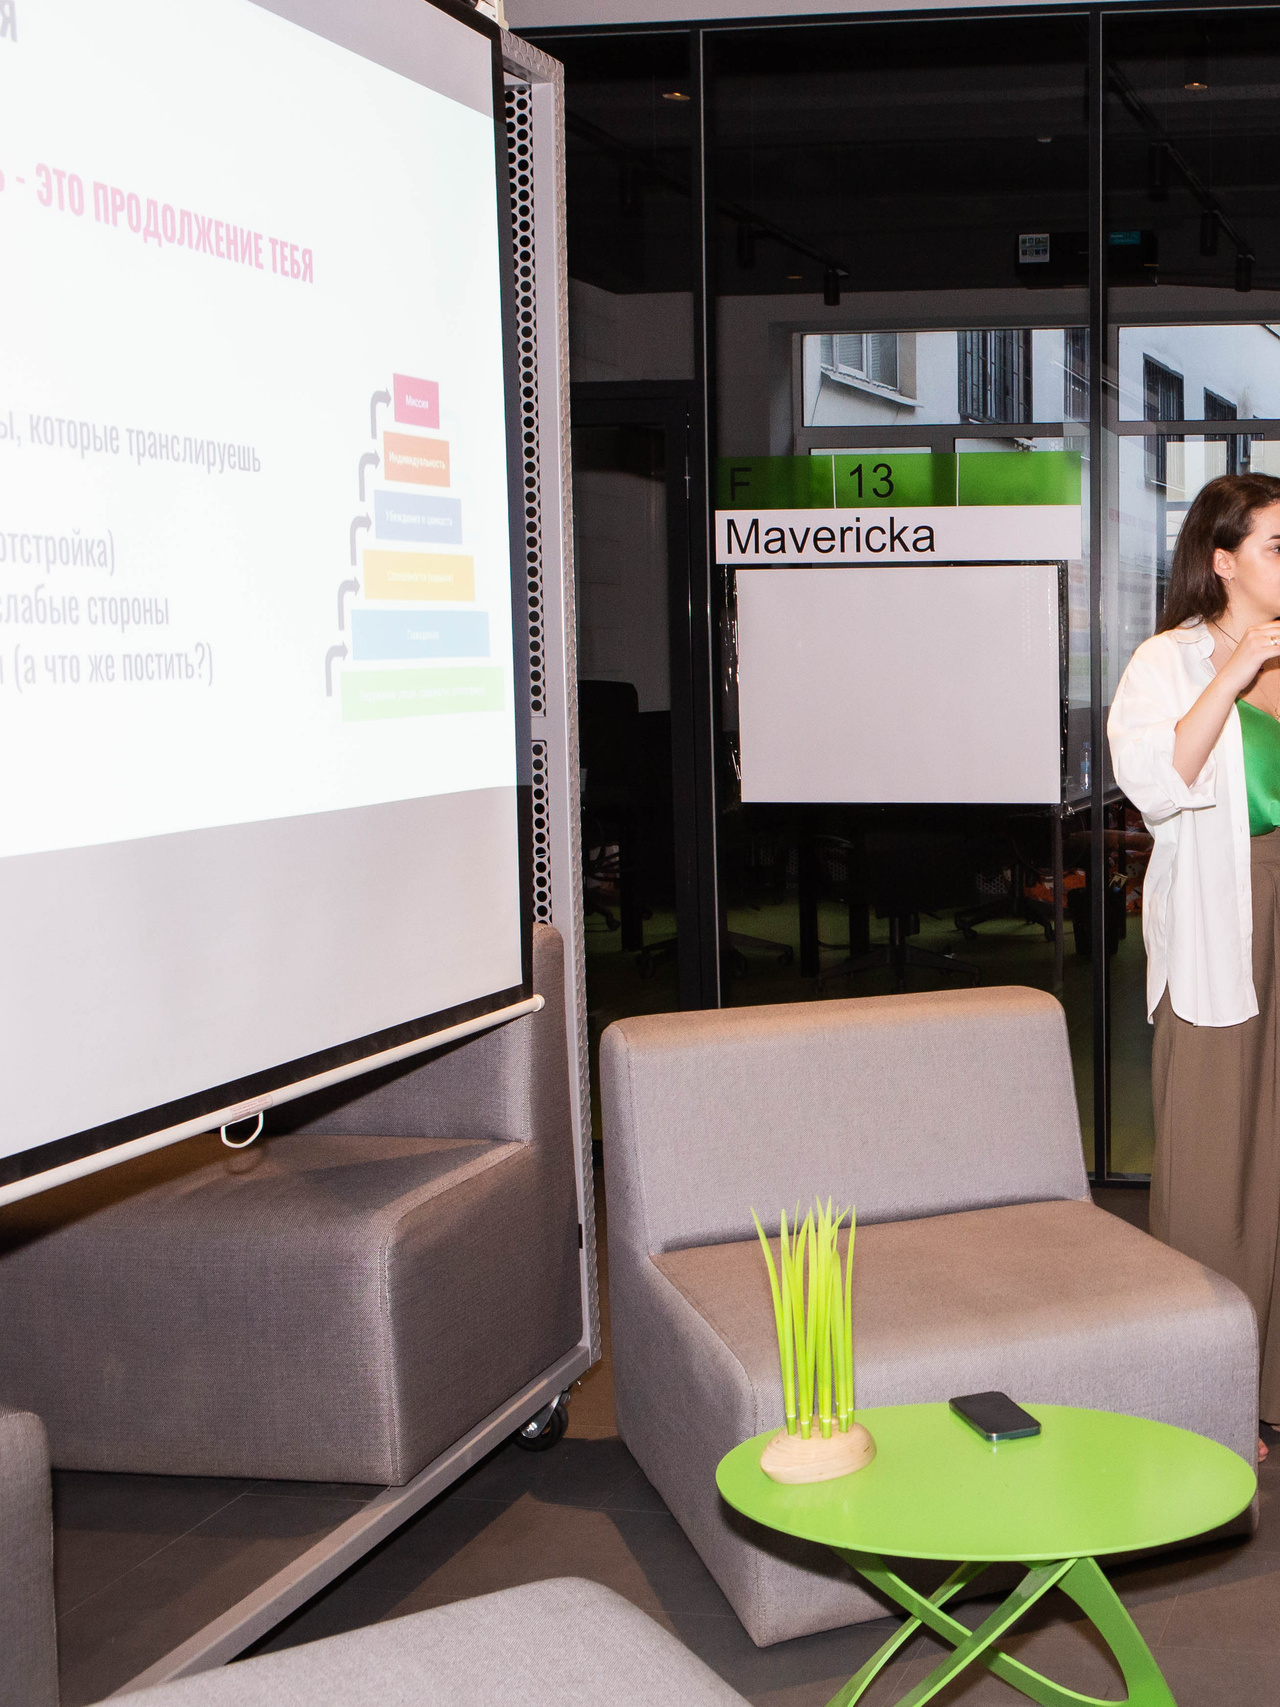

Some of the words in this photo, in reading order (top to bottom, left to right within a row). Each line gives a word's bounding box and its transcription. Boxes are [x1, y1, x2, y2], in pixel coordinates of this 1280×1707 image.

[35, 162, 84, 217] ЭТО
[93, 180, 264, 269] ПРОДОЛЖЕНИЕ
[269, 236, 314, 283] ТЕБЯ
[29, 413, 120, 459] которые
[126, 427, 262, 475] транслируешь
[730, 467, 752, 501] F
[848, 463, 895, 499] 13
[726, 516, 936, 554] Mavericka
[0, 583, 80, 625] лабые
[87, 595, 170, 634] стороны
[14, 643, 36, 694] (а
[44, 654, 80, 684] что
[88, 652, 116, 683] же
[122, 641, 214, 688] постить?)
